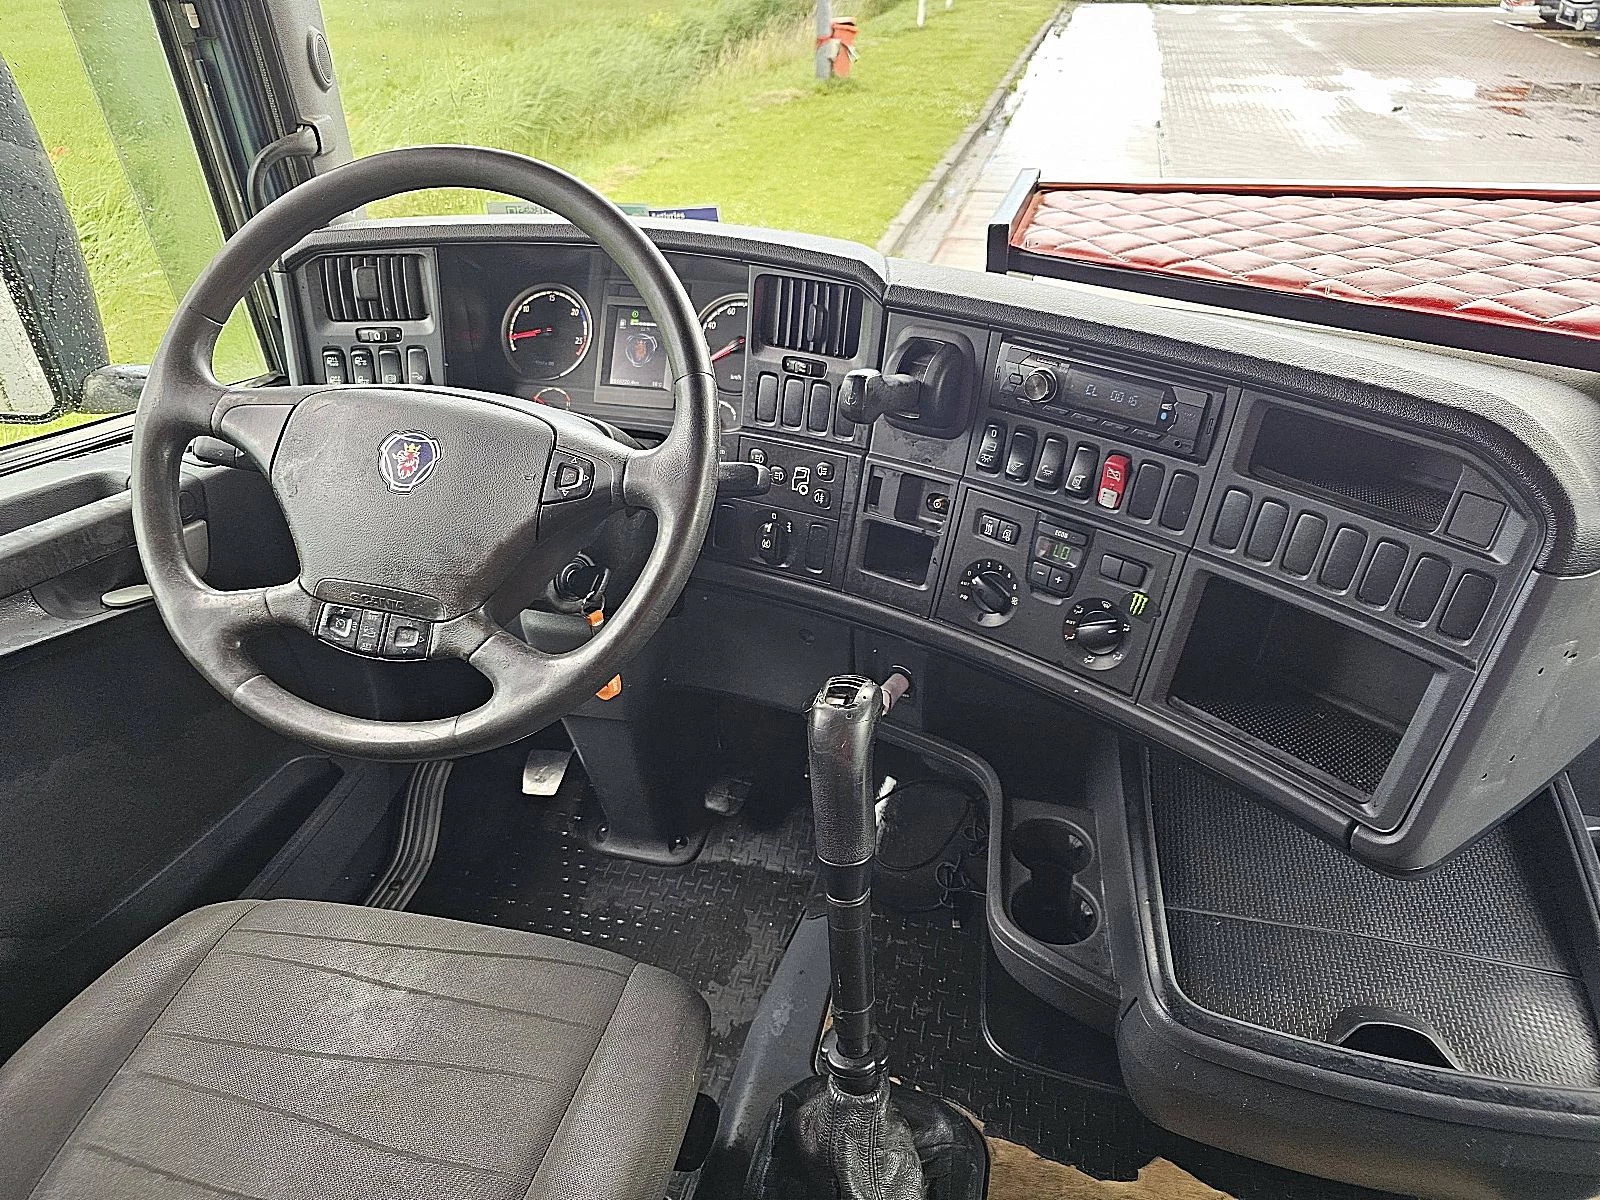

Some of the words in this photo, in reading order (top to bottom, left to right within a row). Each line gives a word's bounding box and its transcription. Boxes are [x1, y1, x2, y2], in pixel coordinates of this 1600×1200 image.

[570, 308, 579, 316] 20
[727, 307, 736, 316] 60
[708, 321, 716, 330] 40
[575, 336, 583, 344] 25
[1054, 529, 1069, 539] ECON
